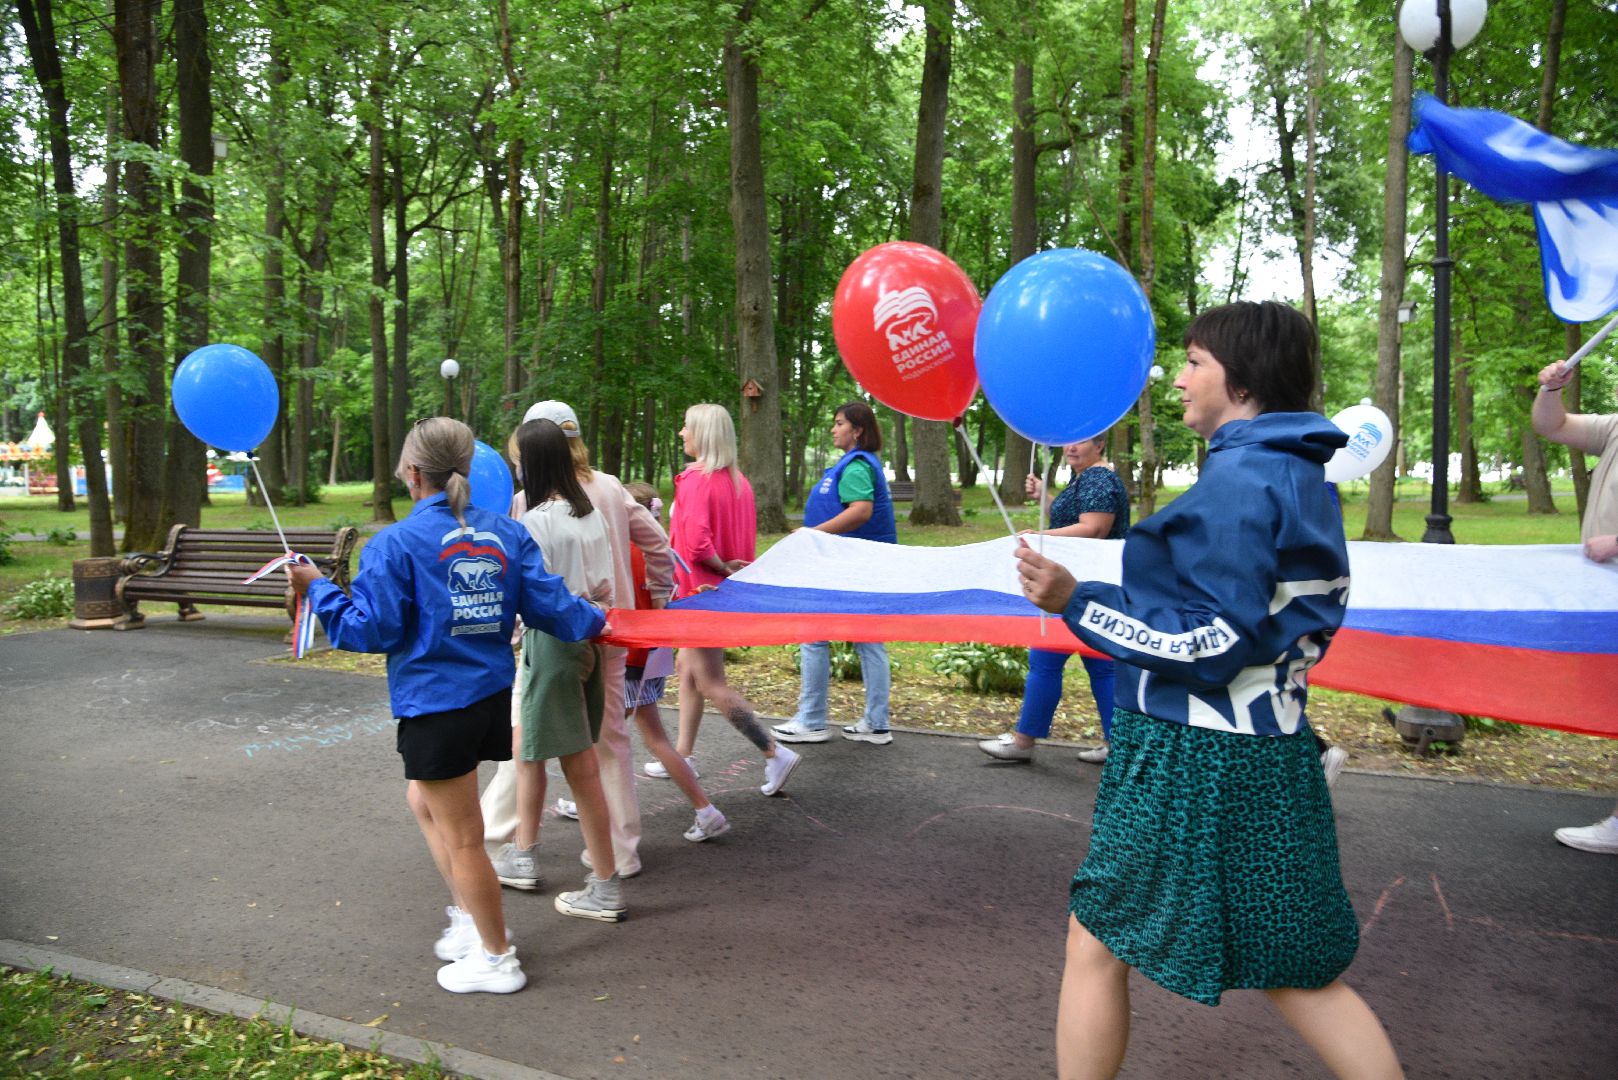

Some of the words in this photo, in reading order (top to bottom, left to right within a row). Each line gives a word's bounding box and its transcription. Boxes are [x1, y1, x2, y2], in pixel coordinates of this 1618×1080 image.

[891, 330, 946, 364] ЕДИНАЯ
[896, 340, 952, 374] РОССИЯ
[453, 604, 503, 621] РОССИ
[1089, 609, 1163, 651] РОССИЯ
